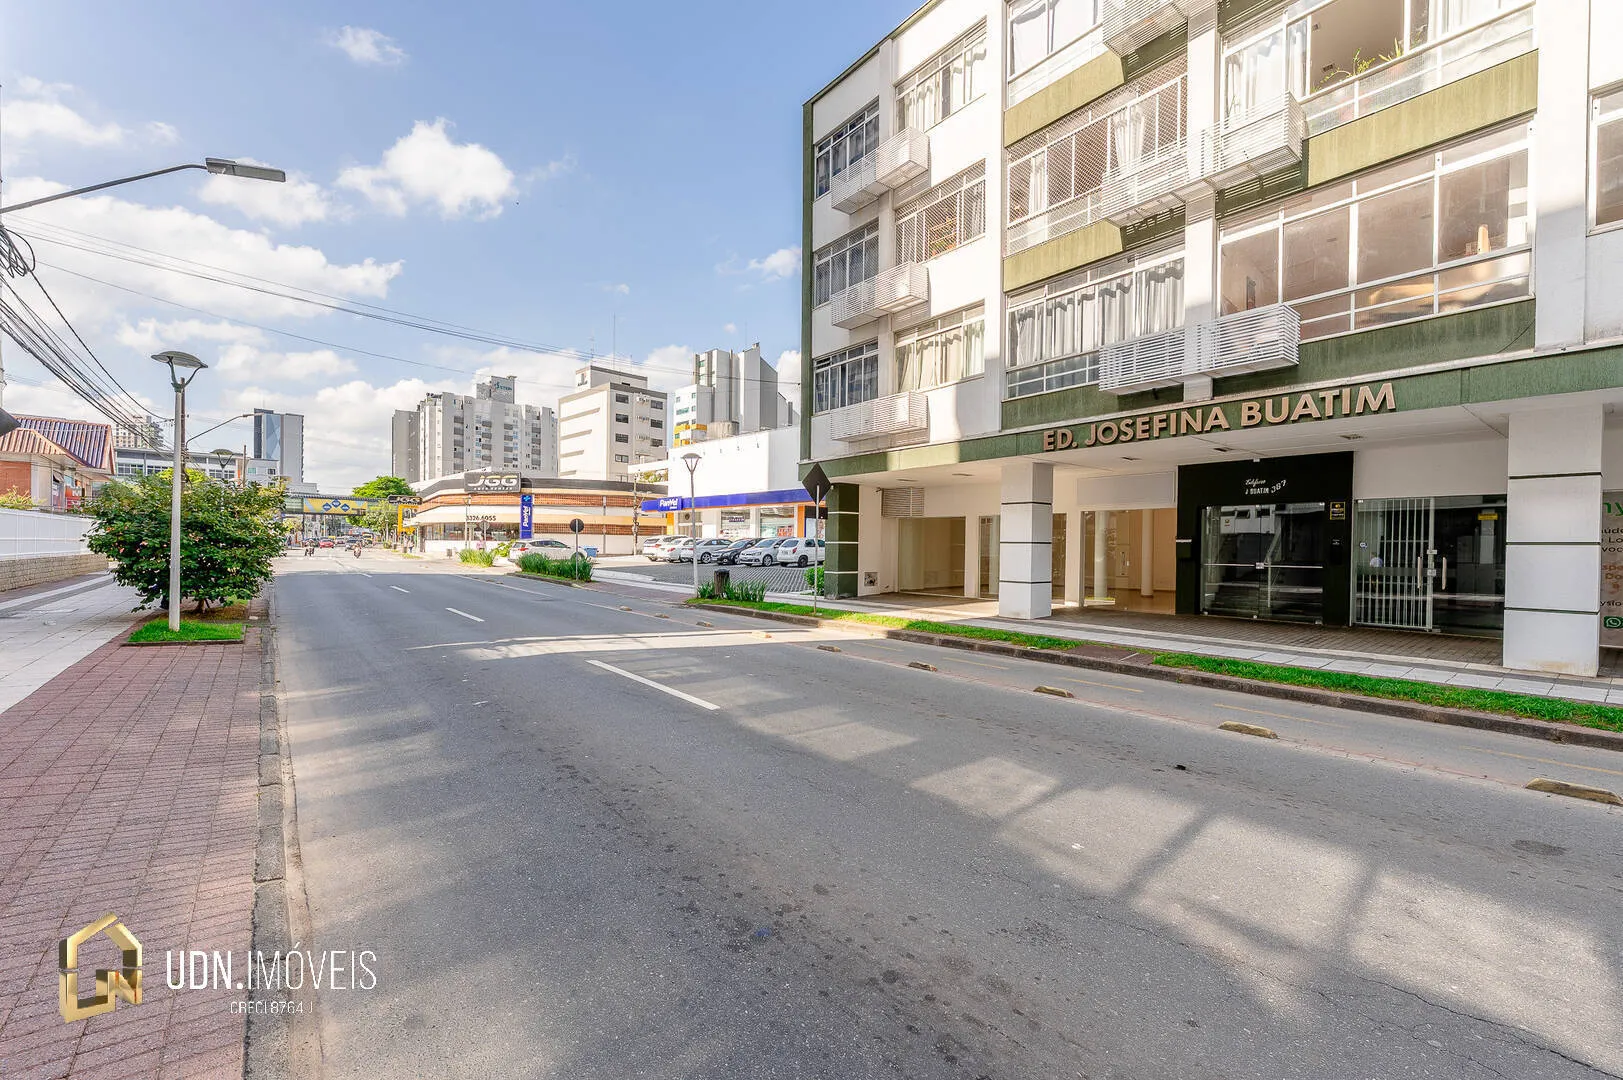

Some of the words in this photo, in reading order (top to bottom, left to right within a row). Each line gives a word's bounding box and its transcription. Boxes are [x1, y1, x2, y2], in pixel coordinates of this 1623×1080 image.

[1043, 430, 1079, 451] ED.
[1085, 407, 1230, 447] JOSEFINA
[1241, 382, 1396, 427] BUATIM
[467, 475, 518, 487] JGG
